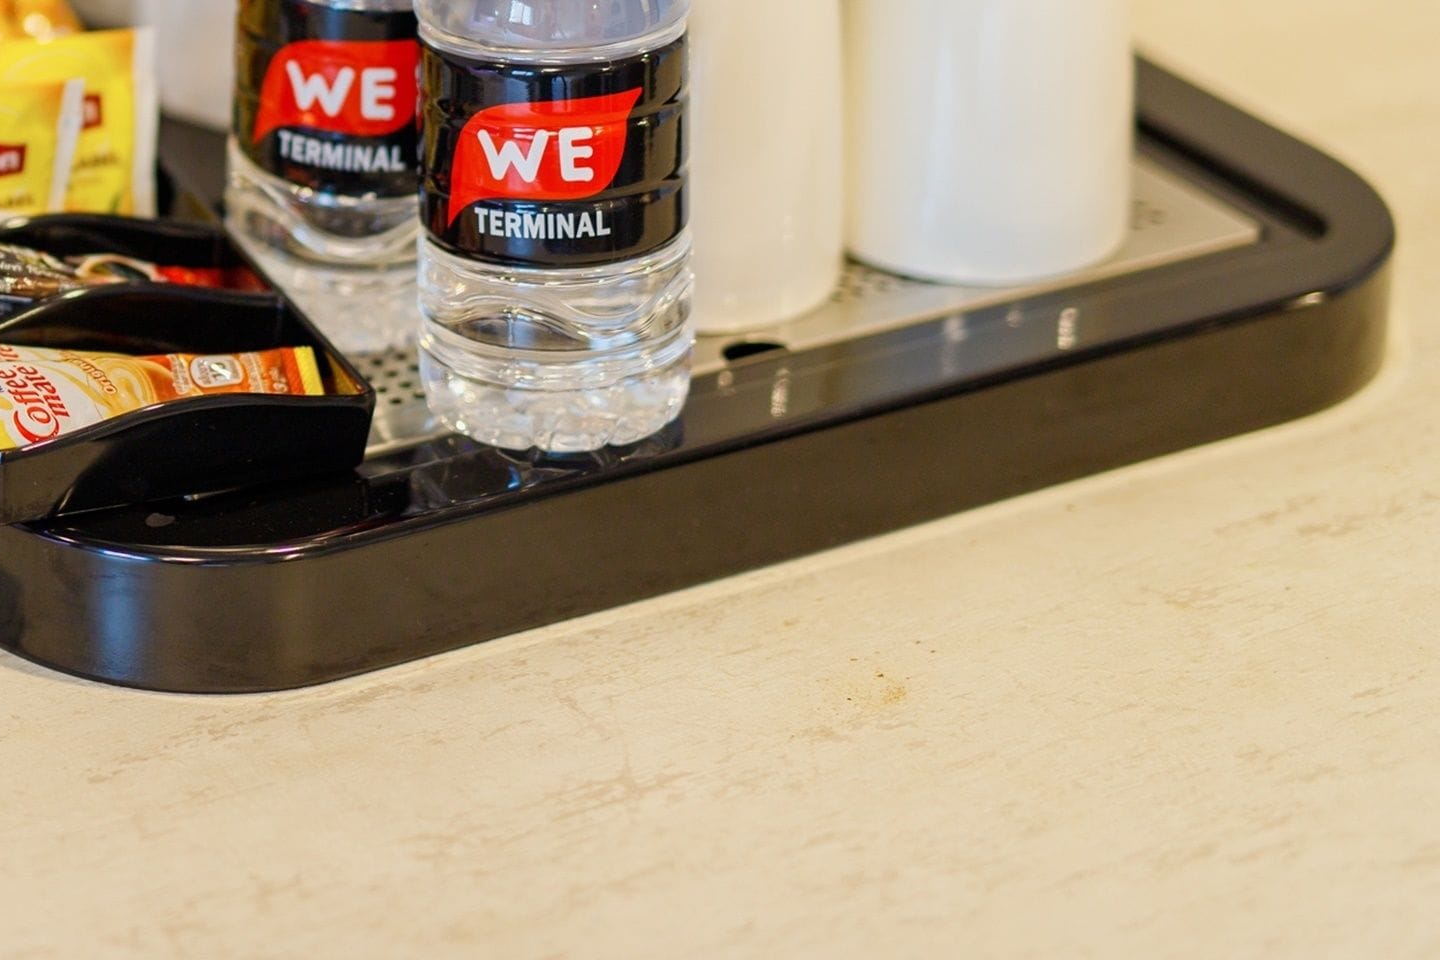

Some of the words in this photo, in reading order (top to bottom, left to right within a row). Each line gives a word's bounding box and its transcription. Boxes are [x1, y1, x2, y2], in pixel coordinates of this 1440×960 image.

[285, 59, 397, 121] WE
[278, 131, 406, 173] TERMINAL
[477, 126, 594, 183] WE
[474, 206, 611, 240] TERMINAL
[16, 365, 71, 418] mate
